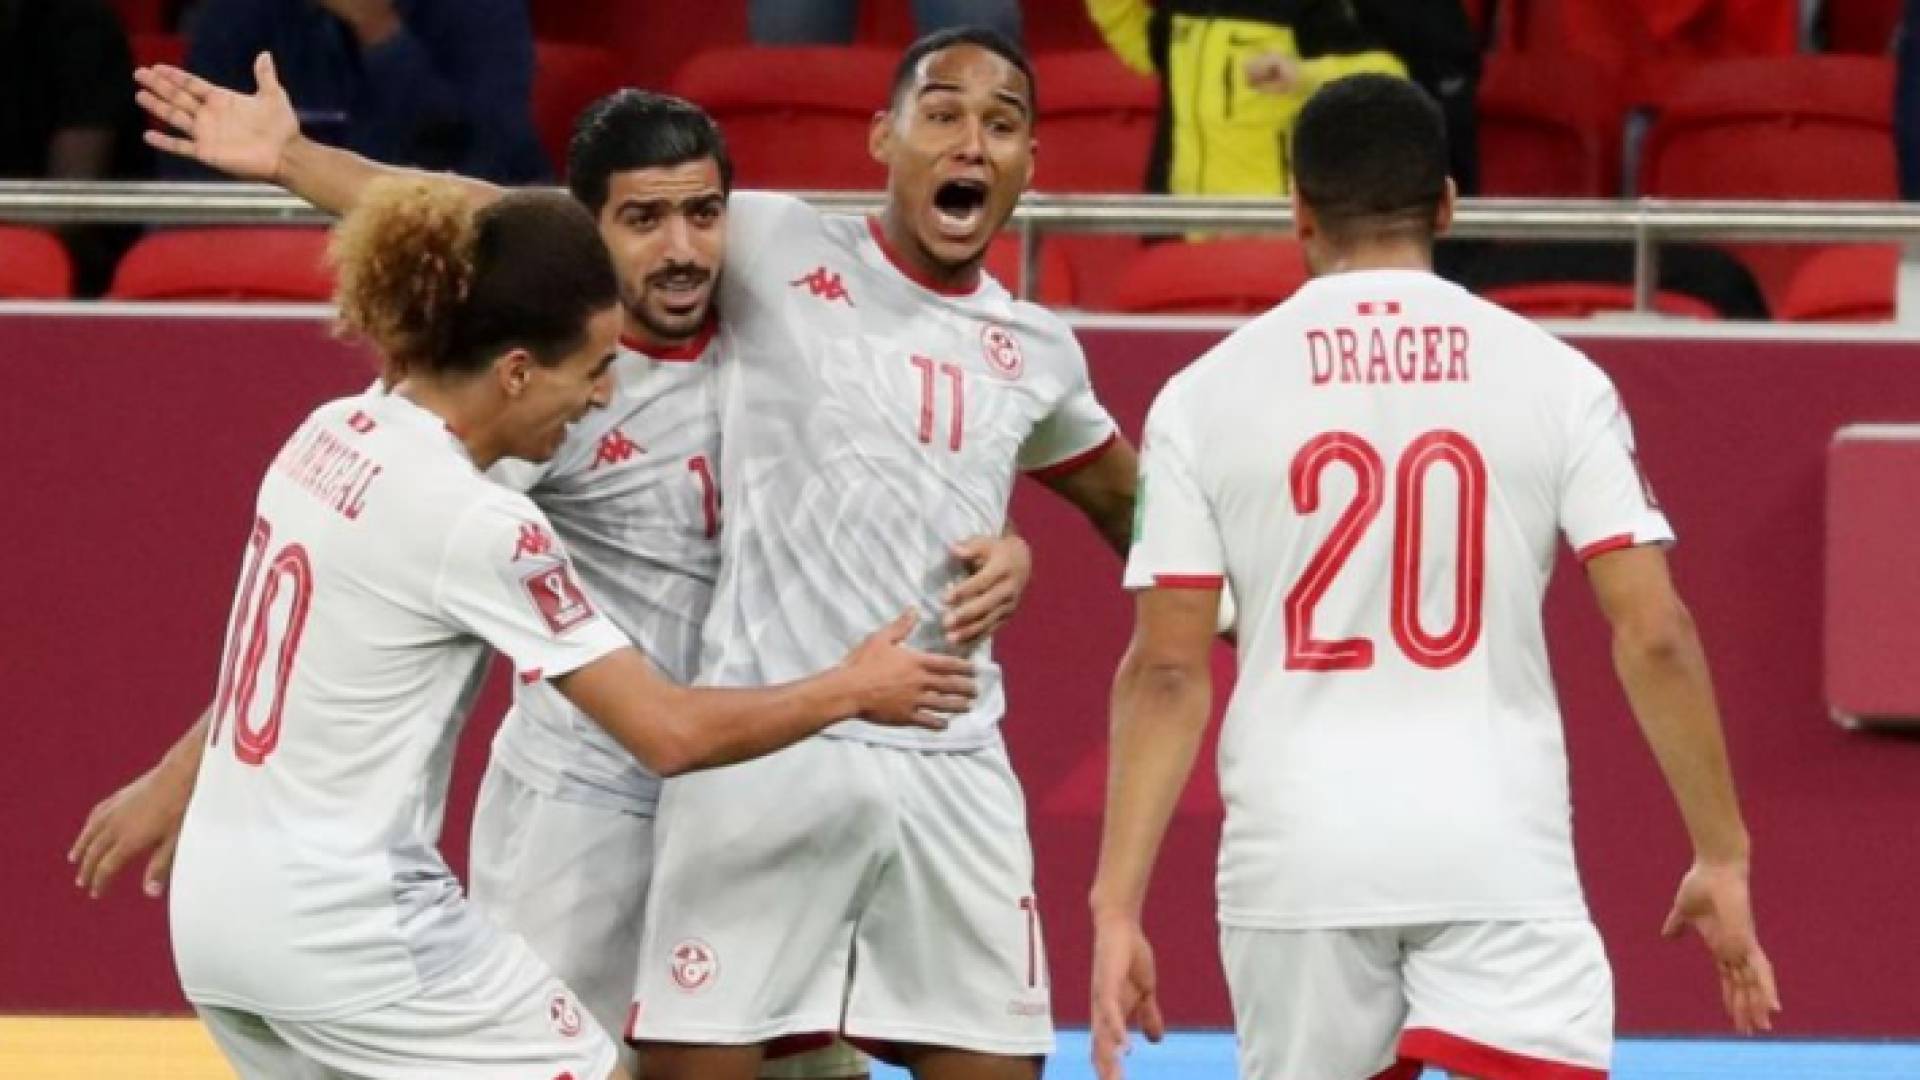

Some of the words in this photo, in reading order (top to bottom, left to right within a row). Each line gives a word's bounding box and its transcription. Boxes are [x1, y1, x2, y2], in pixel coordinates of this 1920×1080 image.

[911, 353, 964, 452] 11
[1306, 327, 1470, 384] DRAGER
[1284, 429, 1487, 670] 20
[210, 516, 313, 765] 10
